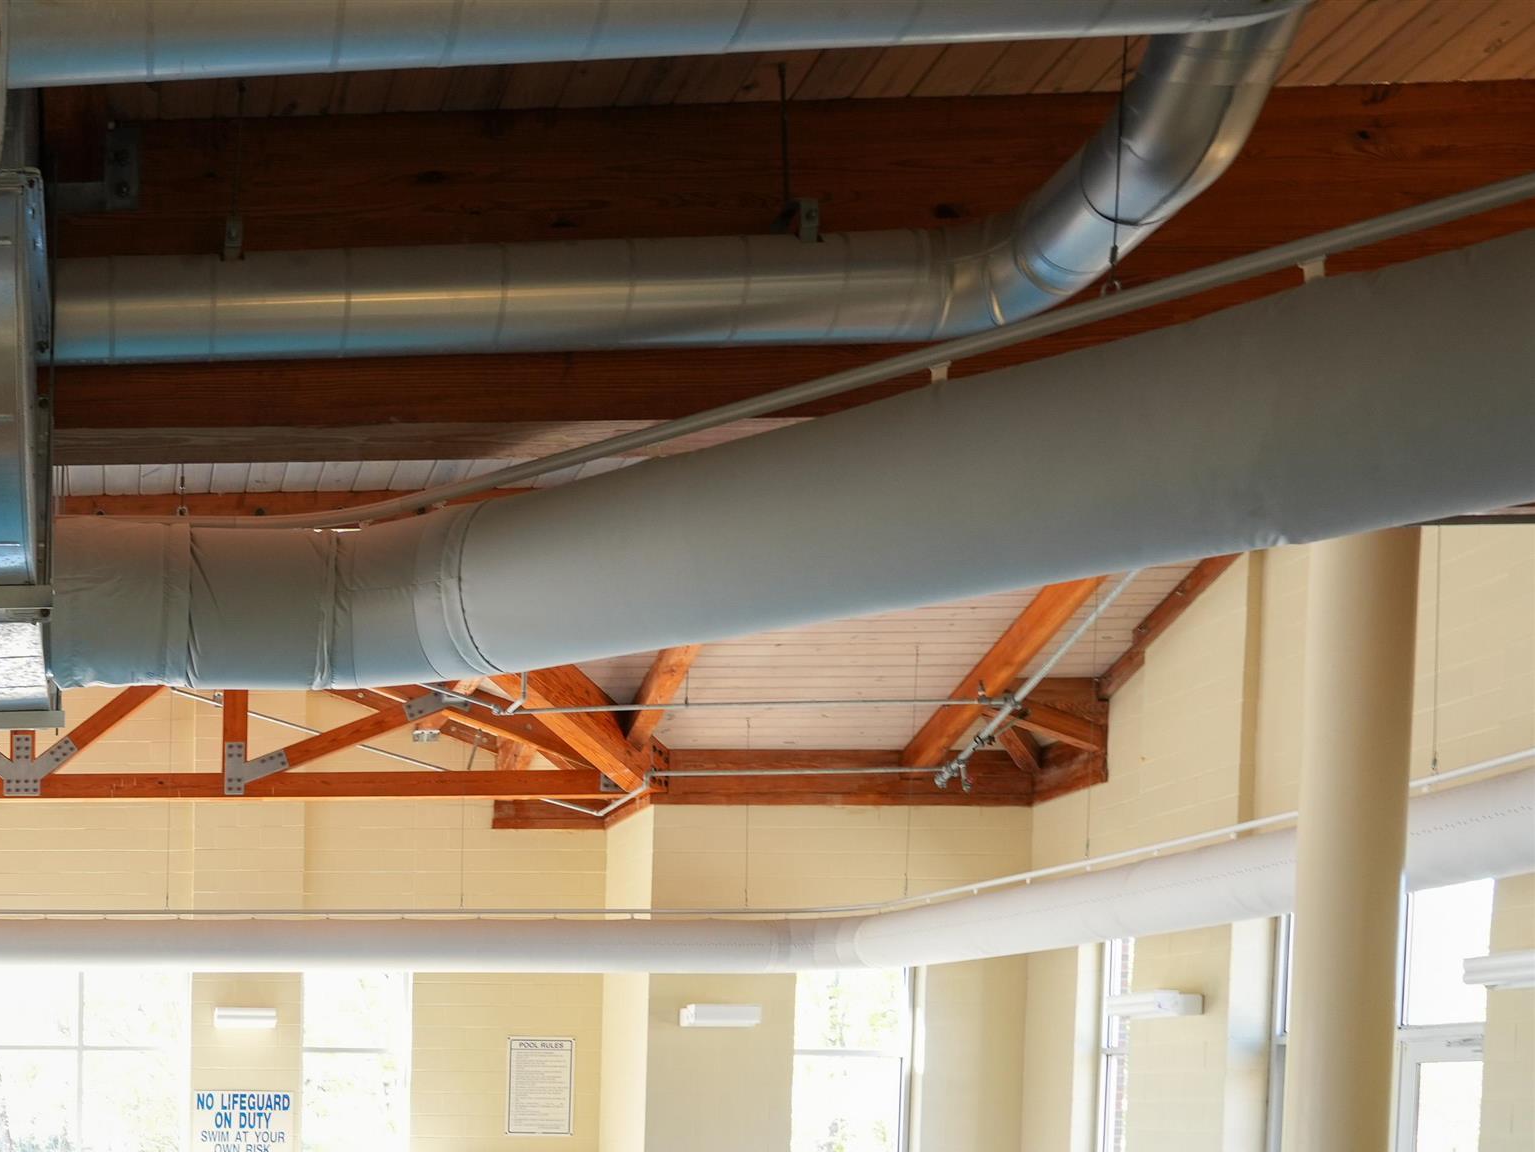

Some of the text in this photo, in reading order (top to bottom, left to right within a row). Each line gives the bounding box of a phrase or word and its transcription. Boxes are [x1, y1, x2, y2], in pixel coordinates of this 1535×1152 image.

[197, 1093, 290, 1111] NO LIFEGUARD
[215, 1112, 271, 1129] ON DUTY
[201, 1130, 285, 1143] SWIM AT YOUR
